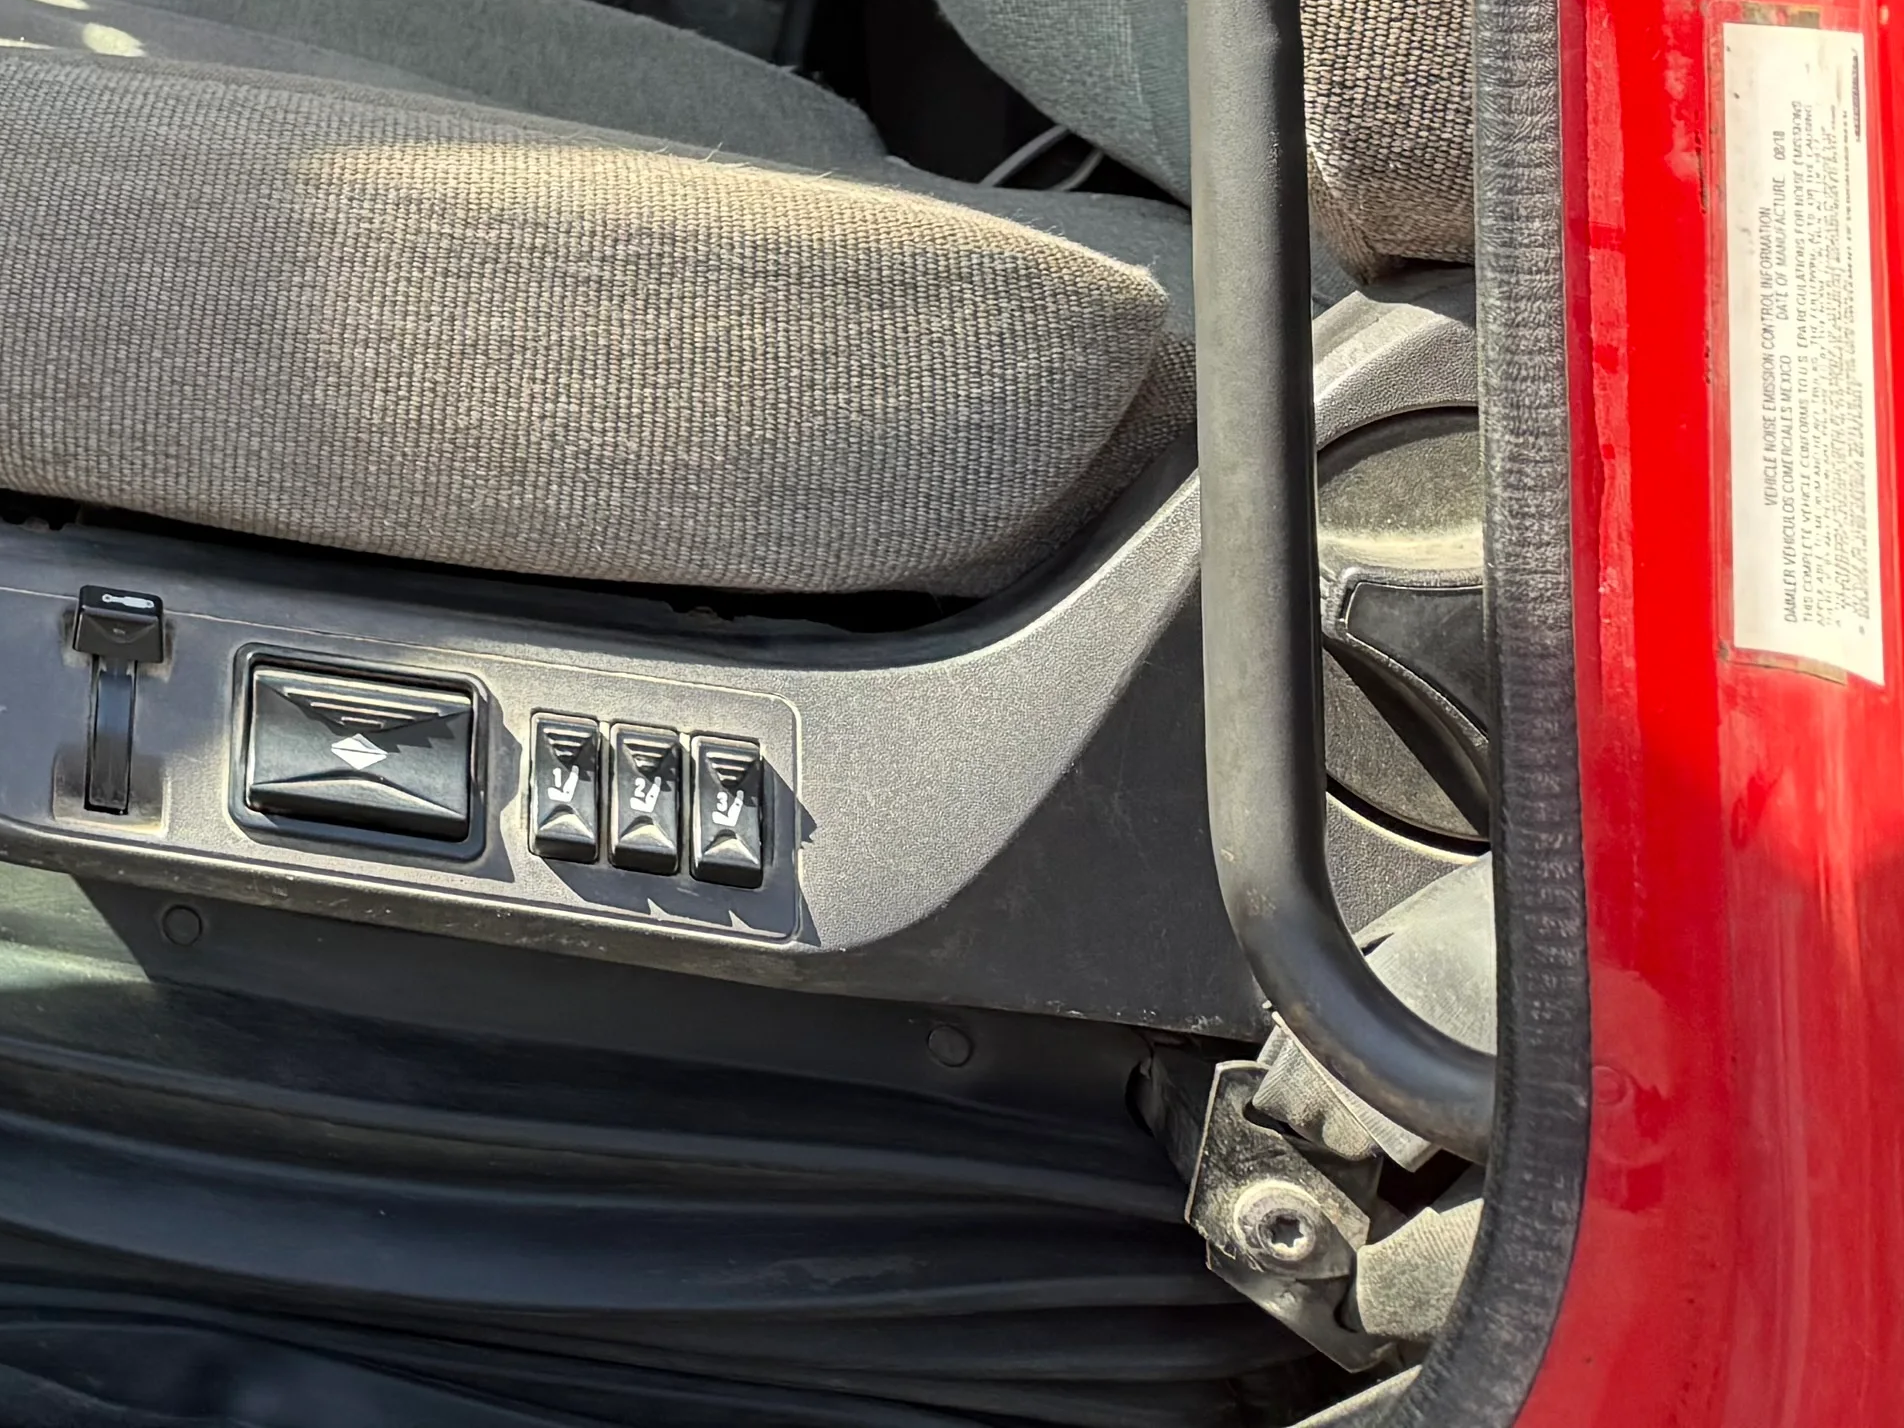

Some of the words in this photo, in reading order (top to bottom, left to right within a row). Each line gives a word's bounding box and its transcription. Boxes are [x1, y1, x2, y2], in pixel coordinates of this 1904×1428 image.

[1772, 174, 1787, 267] MANUFACTURE
[1758, 206, 1773, 289] INFORMATION
[1774, 270, 1788, 286] OF
[1759, 292, 1775, 350] CONTROL
[1774, 290, 1789, 321] DATE
[1761, 353, 1777, 411] EMISSION
[1779, 354, 1793, 402] MEXICO
[1762, 414, 1777, 452] NOISE
[1780, 405, 1795, 494] COMERCIALES
[1762, 455, 1778, 506] VEHICLE
[1781, 495, 1796, 565] VEHICULOS
[1783, 568, 1797, 623] DAIMLER
[634, 778, 646, 798] 2
[716, 791, 728, 812] 3
